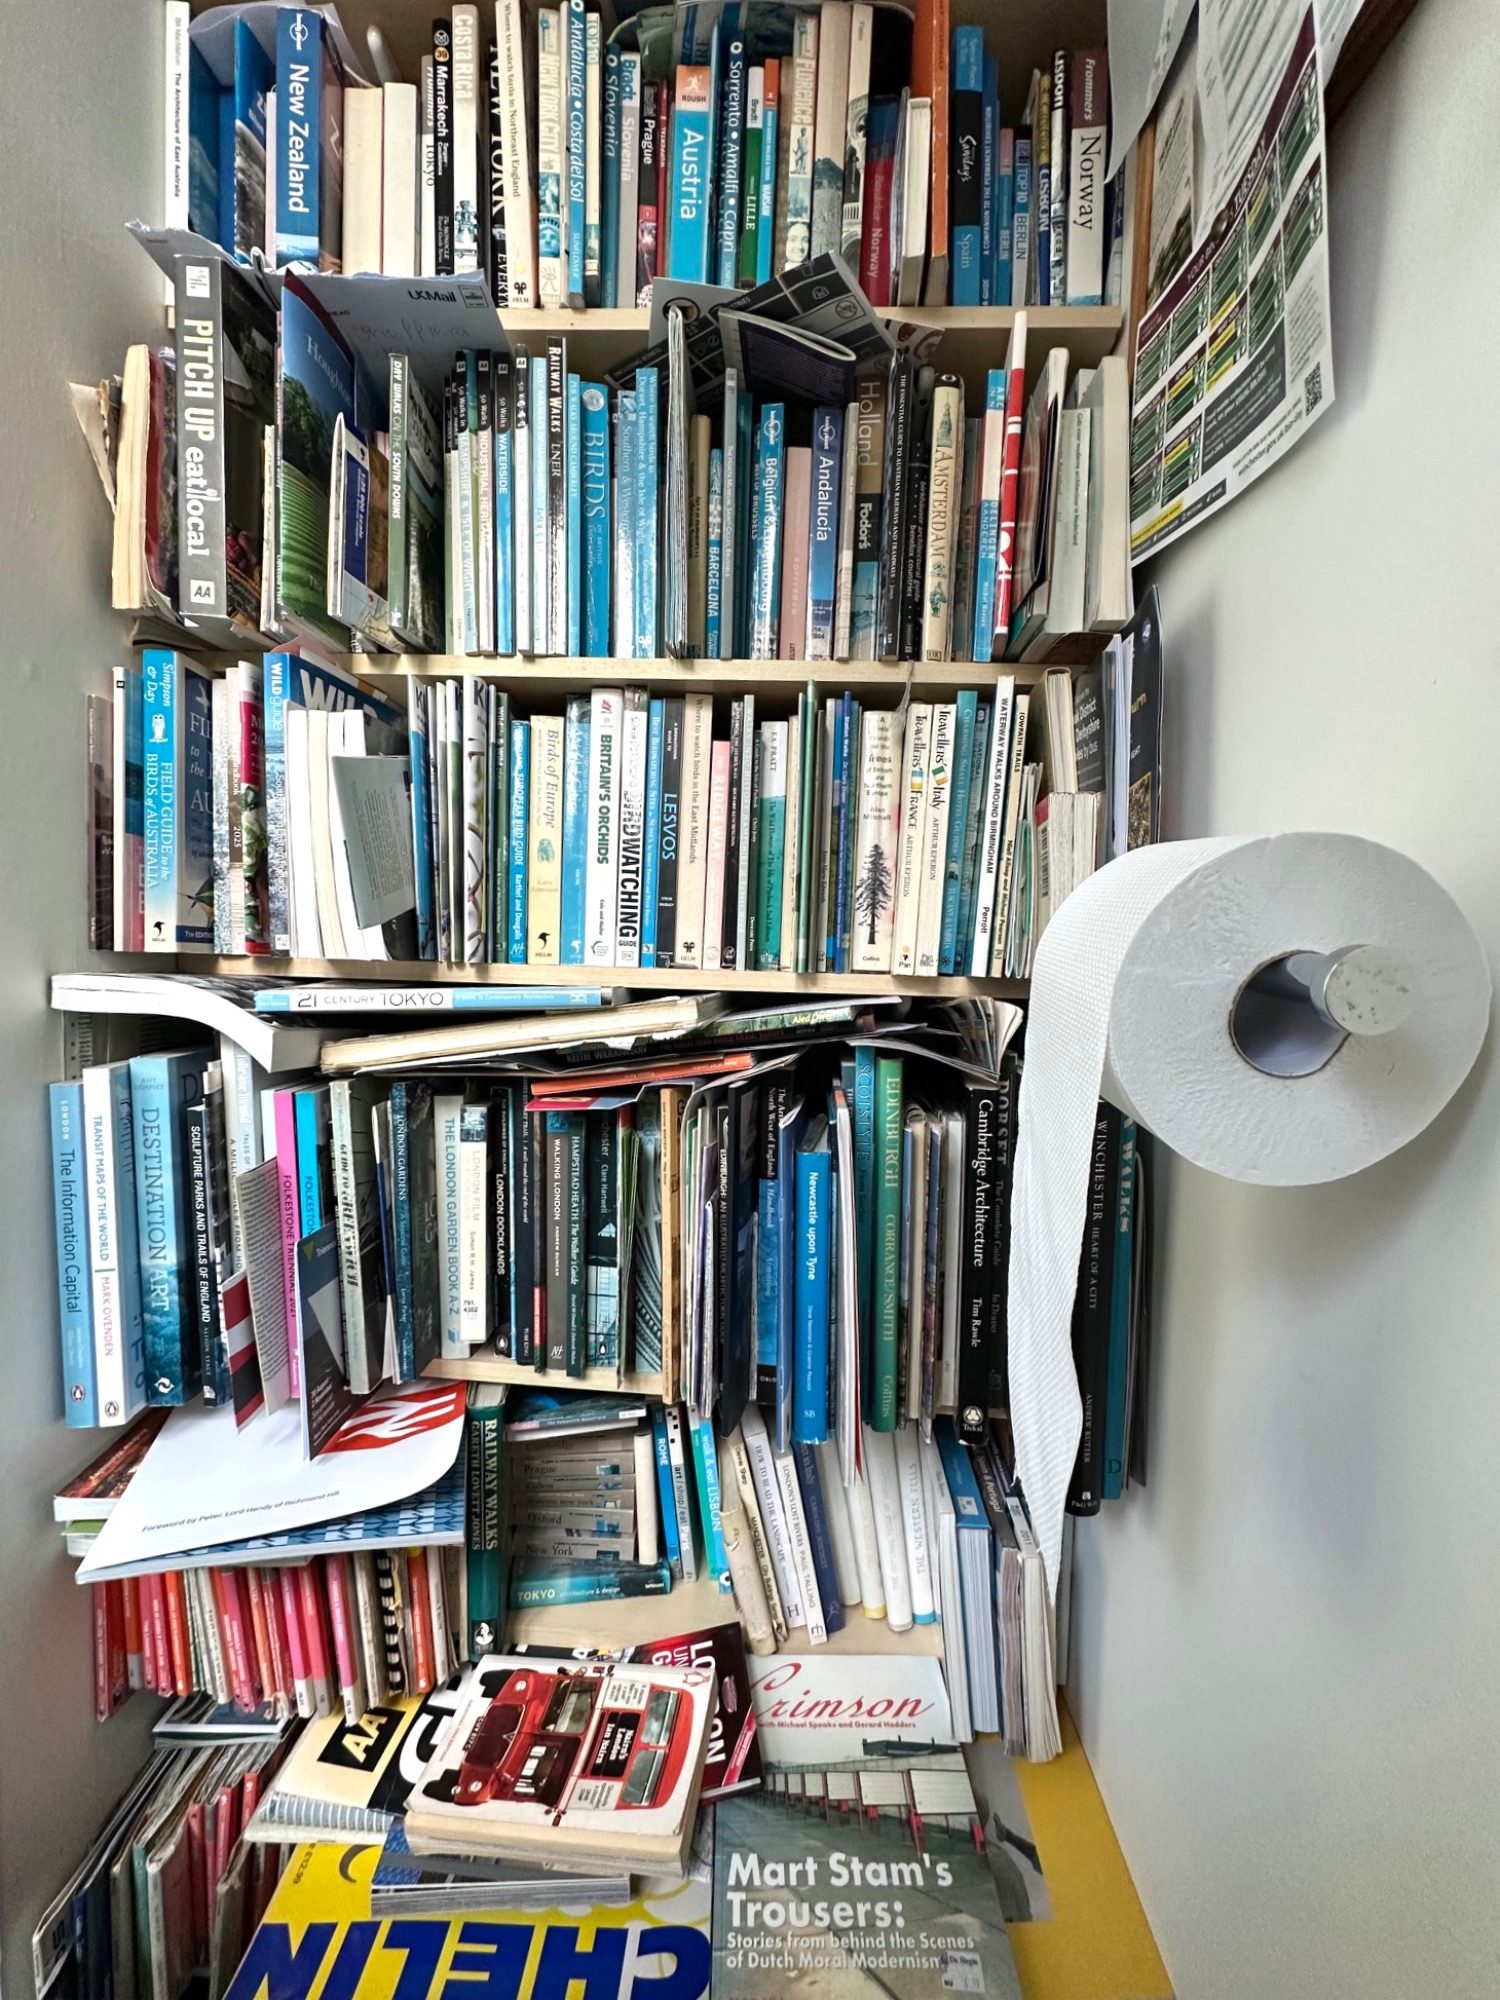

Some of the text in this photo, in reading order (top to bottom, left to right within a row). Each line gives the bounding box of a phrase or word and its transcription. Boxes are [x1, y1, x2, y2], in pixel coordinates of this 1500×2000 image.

[437, 65, 449, 136] Marrakech
[570, 18, 585, 202] Andalucía Costa del Sol
[605, 75, 618, 156] Slovenia
[620, 59, 636, 181] Bradt Slovenia
[728, 61, 742, 127] Sorrento
[288, 64, 310, 212] New Zealand
[643, 119, 654, 164] Prague
[680, 128, 704, 219] Austria
[725, 143, 740, 193] Amalfi
[746, 98, 760, 230] Bradt LILLE
[1074, 58, 1101, 231] Frommer's Norway
[723, 210, 737, 252] Capri
[999, 229, 1010, 260] BERLIN
[1016, 169, 1027, 260] TOP 10 BERLIN
[184, 319, 214, 398] PITCH
[184, 408, 214, 441] UP
[498, 397, 508, 494] 50 Walks WATERSIDE
[582, 431, 606, 518] BIRDS
[816, 457, 834, 540] Andalucía
[929, 448, 953, 558] AMSTERDAM
[708, 546, 719, 617] BARCELONA
[144, 666, 158, 704] & Day
[160, 663, 173, 707] Simpson
[269, 662, 283, 731] WILD guide
[544, 729, 559, 829] Birds of Europe
[597, 734, 612, 864] BRITAIN'S ORCHIDS
[980, 698, 1009, 934] WATERWAY WALKS AROUND BIRMINGHAM Perrott
[146, 753, 159, 888] BIRDS of AUSTRALIA
[161, 762, 173, 880] FIELD GUIDE to the
[233, 826, 242, 848] 2025
[662, 793, 678, 860] LESVOS
[902, 834, 914, 898] ARTHUR EPERON
[323, 995, 375, 1006] CENTURY
[379, 990, 445, 1008] TOKYO
[856, 1063, 872, 1161] SCOTSTYLE
[397, 1115, 407, 1200] LONDON GARDENS
[972, 1099, 992, 1267] Cambridge Architecture
[1092, 1120, 1108, 1220] WINCHESTER
[60, 1100, 81, 1313] LONDON The Information Capital
[92, 1115, 114, 1356] TRANSIT MAPS OF THE WORLD MARK OVENDEN
[141, 1108, 169, 1312] DESTINATION ART
[191, 1126, 212, 1322] SCULPTURE PARKS AND TRAILS OF ENGLAND
[445, 1118, 459, 1315] THE LONDON GARDEN BOOK A-Z
[496, 1173, 505, 1275] LONDON DOCKLANDS
[570, 1136, 581, 1285] HAMPSTEAD HEATH The Walker's Guide
[807, 1172, 818, 1280] Newcastle upon Tyne
[1090, 1227, 1100, 1254] HEART
[881, 1077, 899, 1418] EDINBURGH CORRANCE/SMITH Collins
[1090, 1257, 1098, 1273] OF
[971, 1297, 983, 1348] Tim Rawle
[1088, 1288, 1097, 1310] CITY
[471, 1421, 481, 1550] GARETH LOVETT JONES
[485, 1420, 497, 1550] RAILWAY WALKS
[658, 1438, 668, 1466] ROME
[702, 1434, 714, 1457] walk
[706, 1468, 718, 1484] eat
[142, 1519, 185, 1533] Foreword
[187, 1518, 198, 1528] by
[225, 1509, 244, 1519] Lord
[246, 1505, 273, 1518] Hendy
[274, 1501, 284, 1510] of
[285, 1492, 323, 1509] Richmond
[324, 1490, 340, 1498] Hill
[707, 1486, 723, 1532] LISBON
[783, 1465, 816, 1608] LONDON'S LOST RIVERS PAUL TALLING
[751, 1662, 935, 1719] Crimson
[596, 1723, 615, 1764] Ian Nairn
[609, 1728, 626, 1760] London
[619, 1729, 634, 1760] Nairn's
[727, 1852, 953, 1887] Mart Stam's
[727, 1891, 906, 1928] Trousers:
[726, 1951, 942, 1969] of Dutch Moral Modernism
[727, 1933, 974, 1949] Stories from behind the Scenes
